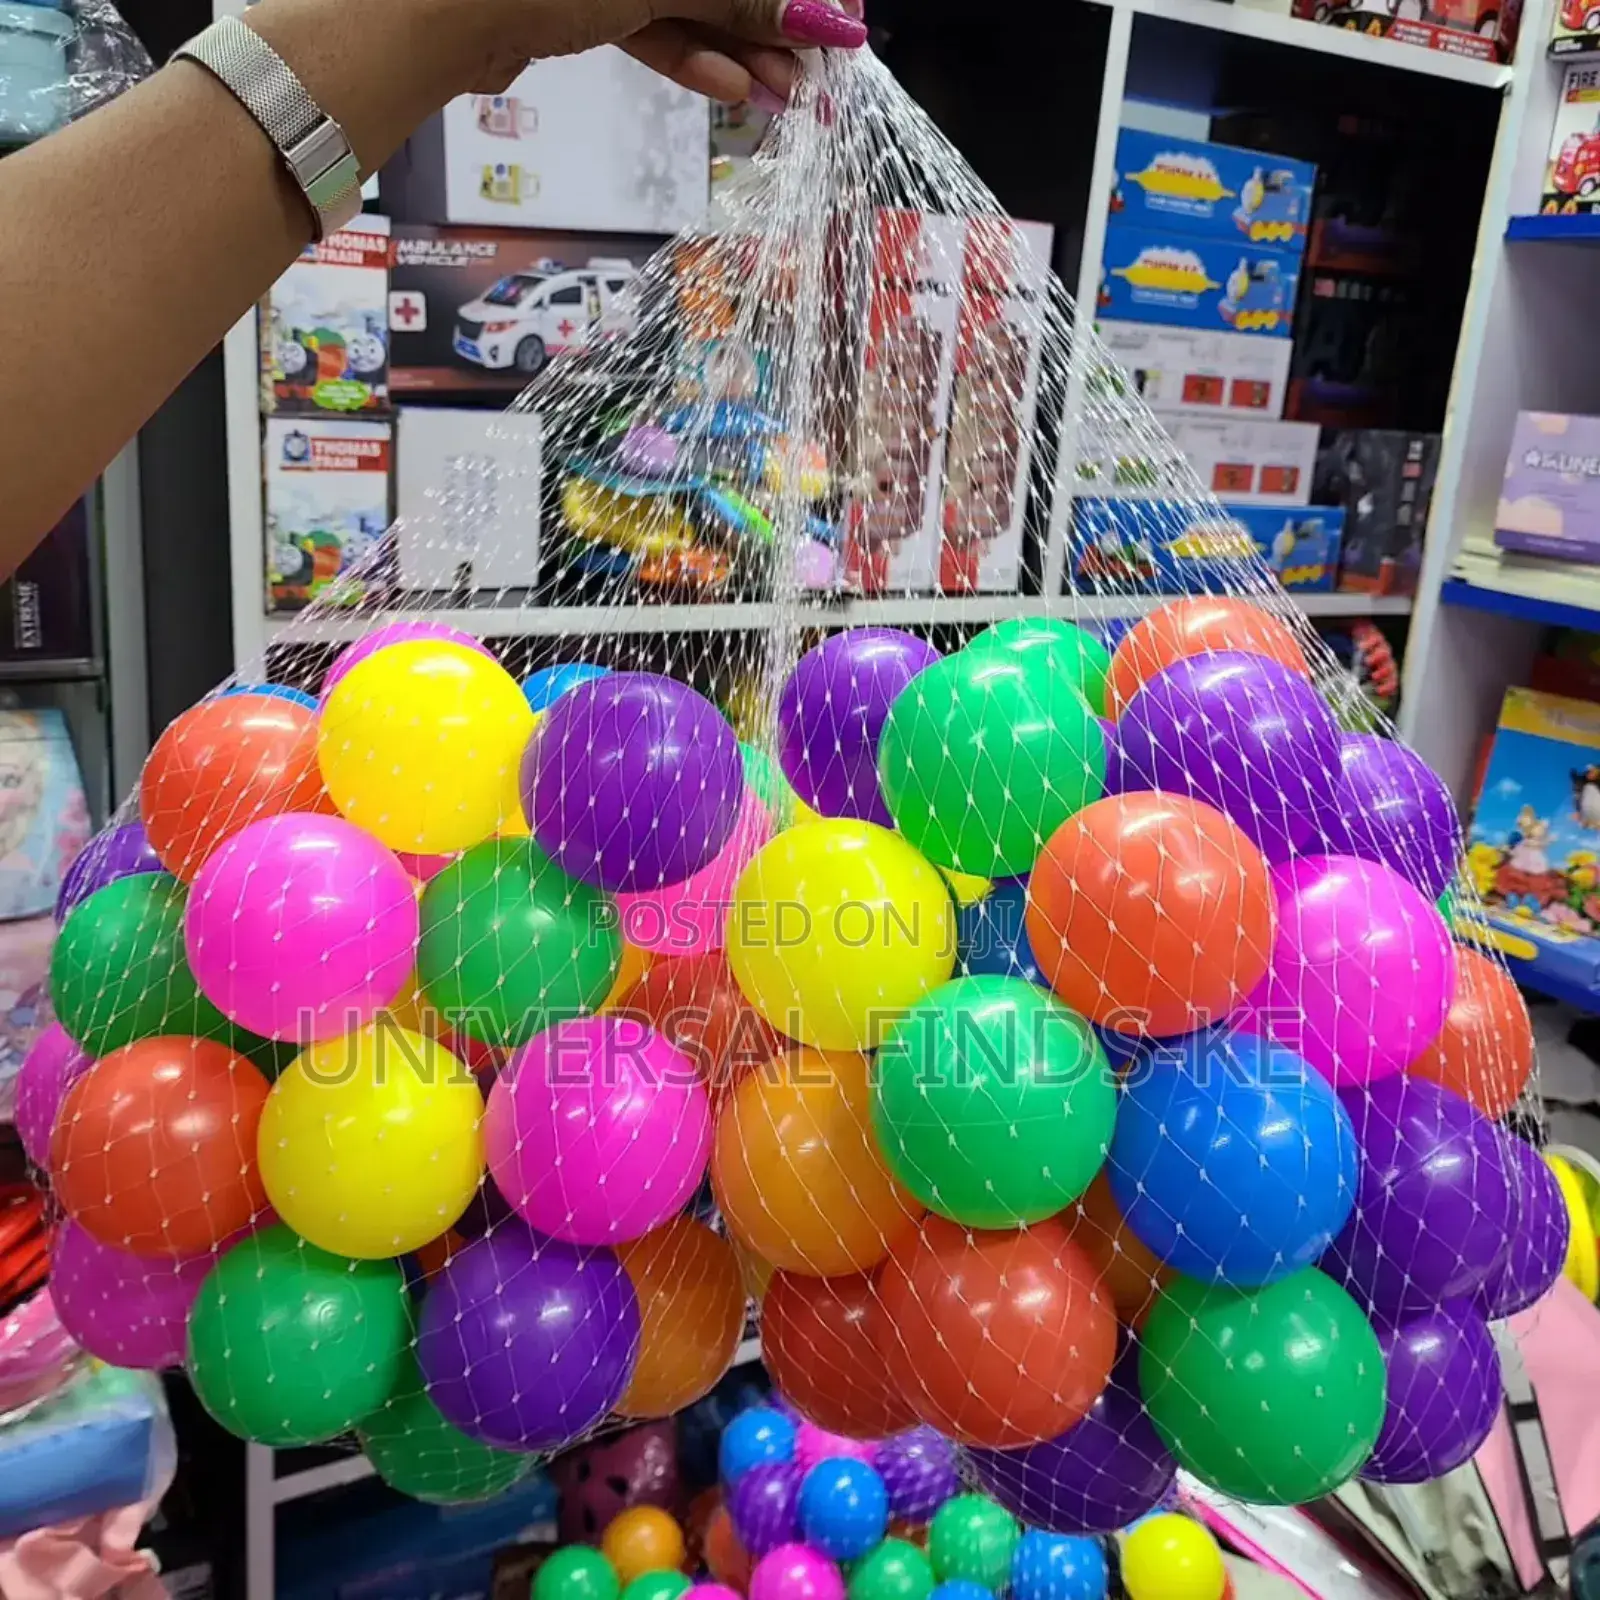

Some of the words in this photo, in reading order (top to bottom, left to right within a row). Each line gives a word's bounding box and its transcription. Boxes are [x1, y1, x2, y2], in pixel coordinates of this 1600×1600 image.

[1568, 70, 1599, 88] FIRE
[318, 248, 364, 265] TRAIN
[314, 439, 381, 457] THOMAS
[314, 455, 359, 469] TRAIN
